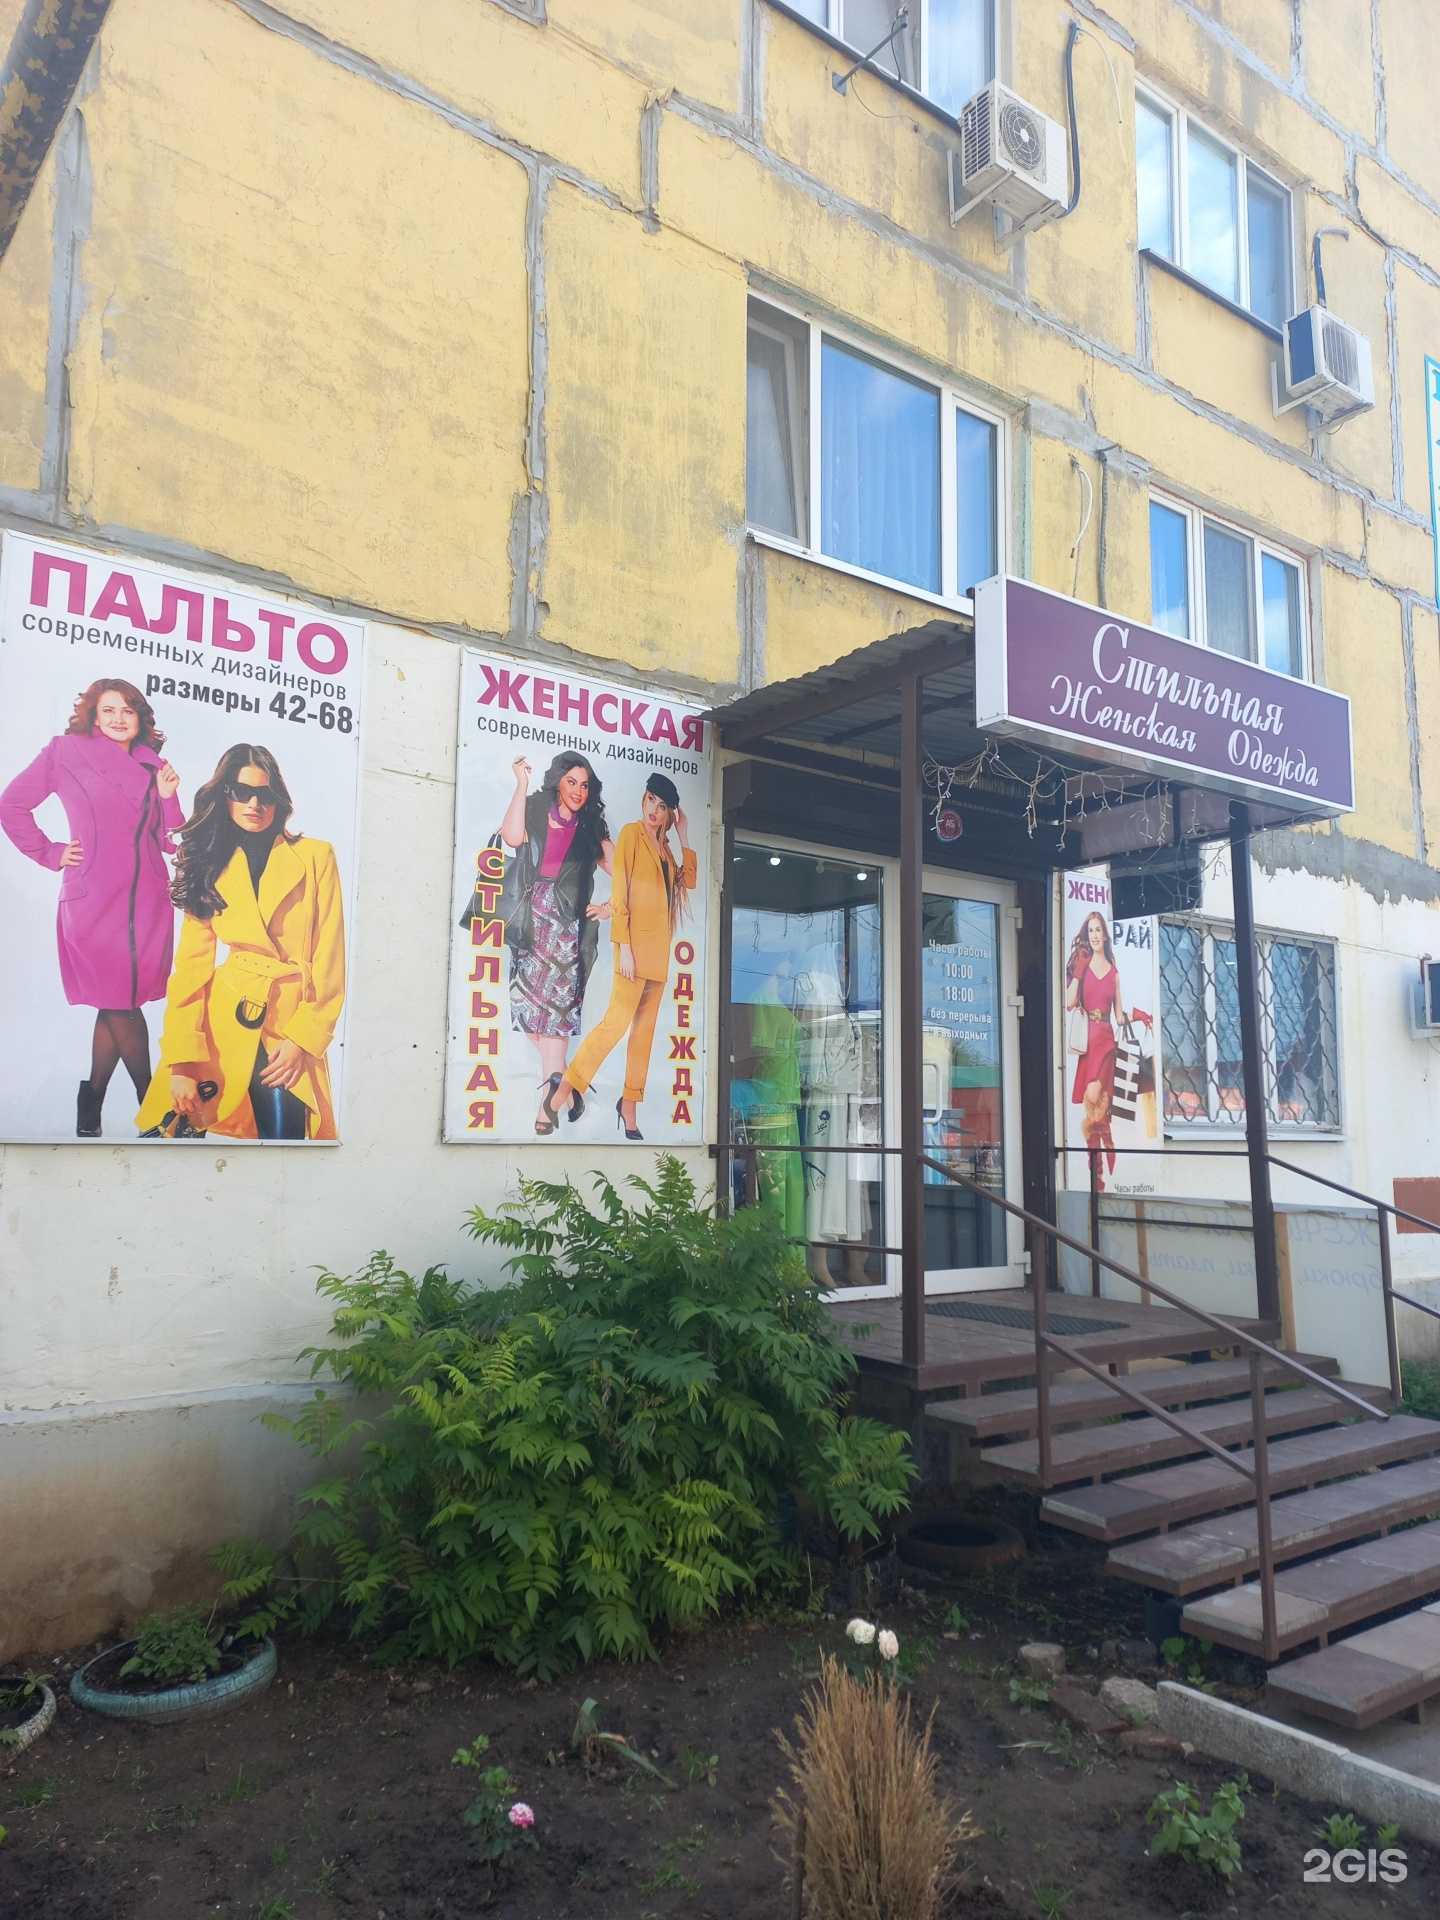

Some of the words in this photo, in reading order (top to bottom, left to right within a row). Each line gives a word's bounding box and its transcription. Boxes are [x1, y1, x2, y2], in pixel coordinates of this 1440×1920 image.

[29, 551, 349, 675] ПАЛЬТО
[22, 613, 204, 668] современных
[211, 654, 347, 701] дизайнеров
[1092, 622, 1285, 735] Стильная
[146, 674, 260, 714] размеры
[269, 691, 353, 734] 42-68
[477, 664, 704, 752] ЖЕНСКАЯ
[1049, 674, 1197, 752] Женская
[1228, 729, 1319, 787] Одежда
[477, 715, 601, 754] современных
[606, 743, 699, 775] дизайнеров
[928, 938, 955, 954] Часы
[958, 946, 992, 959] работы
[944, 962, 973, 979] 10:00
[1113, 919, 1151, 950] РАЙ
[466, 848, 505, 1129] СТИЛЬНАЯ
[930, 1007, 946, 1020] без
[948, 1011, 992, 1024] перерыва
[945, 985, 974, 1002] 18:00
[668, 940, 697, 1124] ОДЕЖДА
